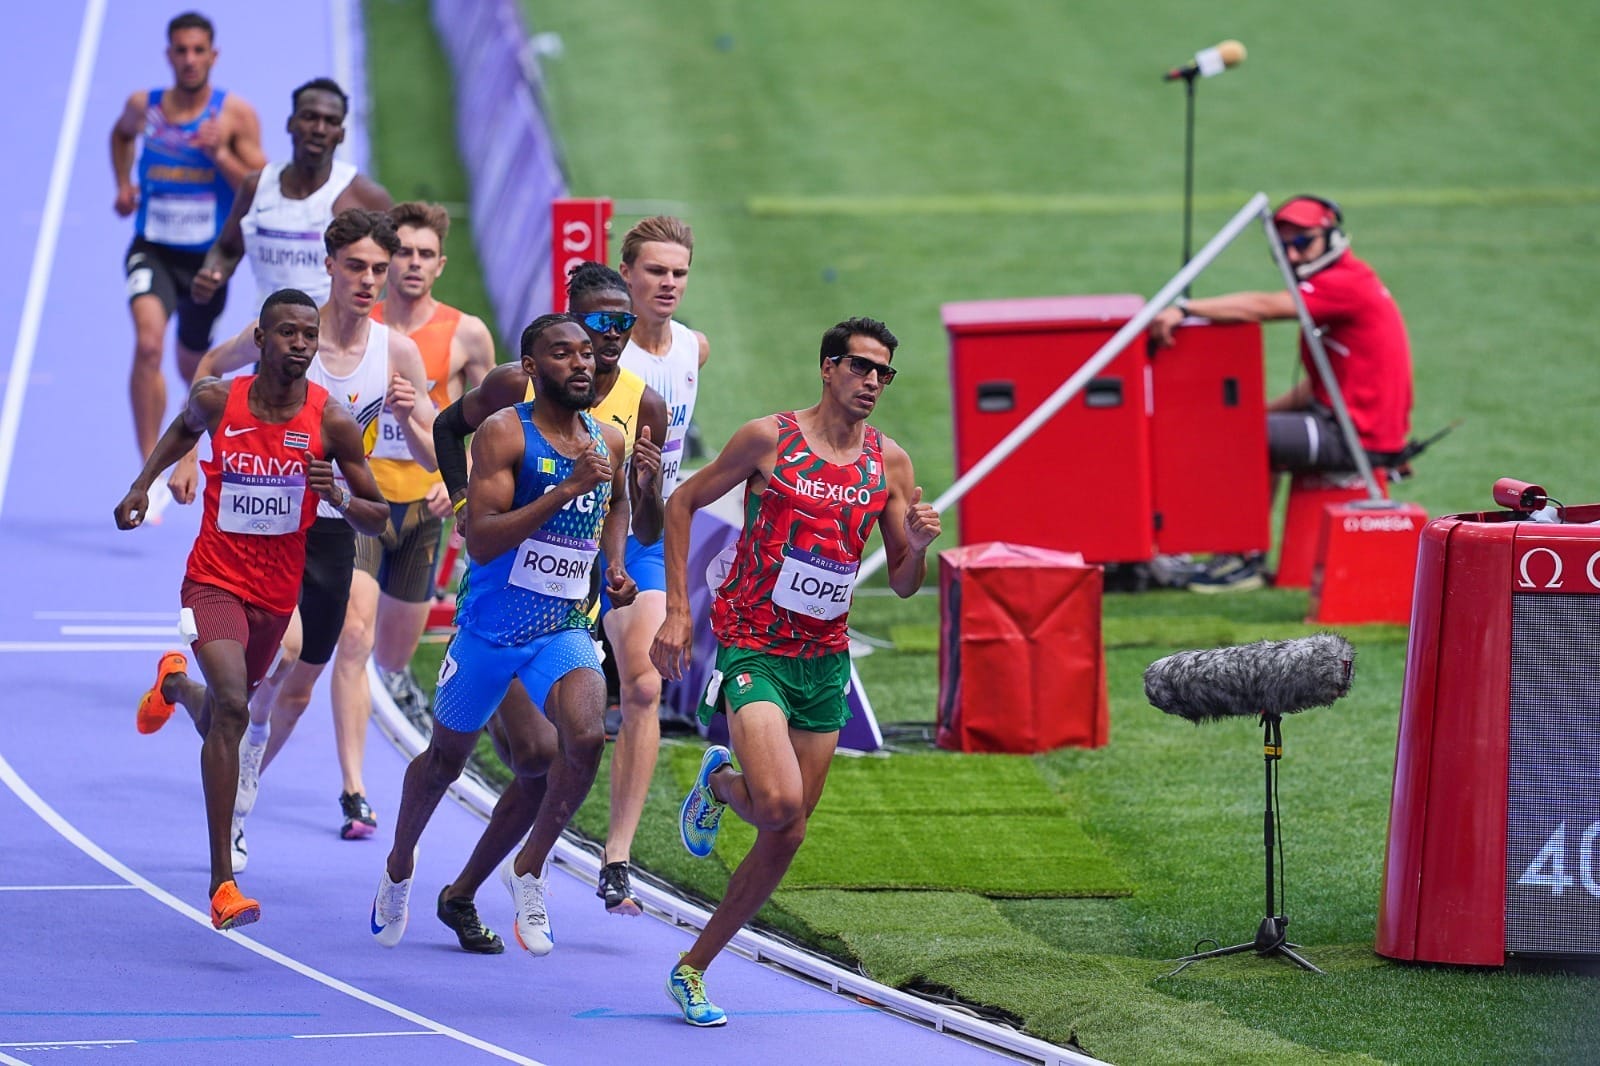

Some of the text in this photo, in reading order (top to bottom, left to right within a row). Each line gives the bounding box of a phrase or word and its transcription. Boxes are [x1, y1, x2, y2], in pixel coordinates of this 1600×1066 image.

[221, 449, 304, 477] KENYA
[241, 475, 287, 485] PARIS 2024
[795, 478, 872, 504] MÉXICO
[231, 487, 291, 517] KIDALI
[1359, 516, 1415, 533] OMEGA
[546, 534, 568, 546] PARIS
[523, 550, 589, 580] ROBAN
[810, 555, 834, 569] PARIS
[790, 572, 850, 604] LOPEZ
